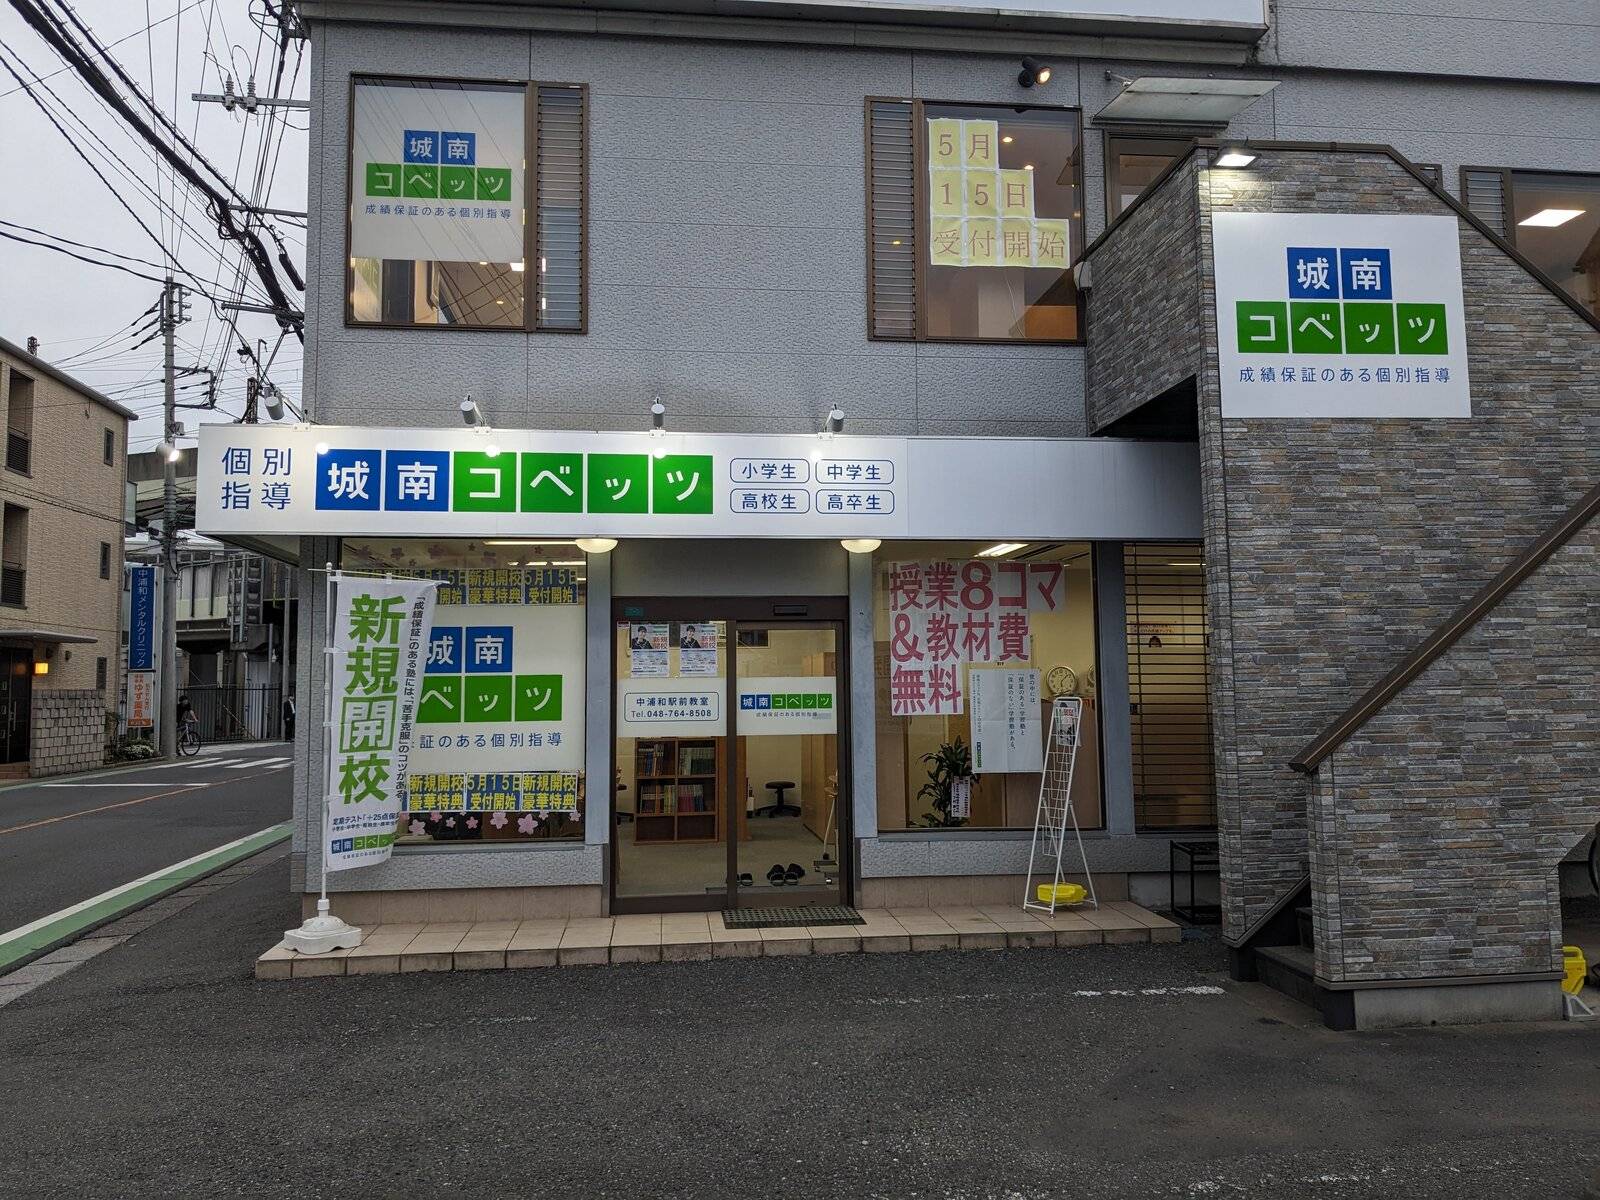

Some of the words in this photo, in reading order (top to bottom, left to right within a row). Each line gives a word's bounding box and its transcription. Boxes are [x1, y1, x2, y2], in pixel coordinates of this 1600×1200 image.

[410, 137, 468, 159] 城南
[938, 133, 990, 160] 5月
[374, 172, 503, 194] コベッツ
[941, 182, 1026, 208] 15日
[365, 204, 513, 219] 成績保証のある個別指導
[934, 229, 1065, 259] 受付開始
[1296, 258, 1381, 290] 城南
[1250, 313, 1435, 343] コベッツ
[1239, 366, 1450, 383] 成績保証のある個別指導
[221, 446, 292, 476] 個別
[742, 462, 797, 480] 小学生
[827, 464, 881, 480] 中学生
[327, 461, 699, 501] 城南コベッツ
[221, 481, 292, 510] 指導
[741, 493, 797, 510] 高校生
[827, 493, 881, 511] 高卒生
[469, 569, 522, 586] 新規開校
[525, 569, 576, 585] 5月15日
[890, 561, 1063, 611] 授業8コマ
[529, 587, 573, 604] 受付開始
[137, 569, 149, 667] 中浦和メンタルクリニック
[891, 612, 1029, 662] &教材費
[892, 664, 962, 714] 無料
[338, 593, 406, 805] 新規開校
[636, 697, 709, 707] 中浦和駅前教室
[742, 696, 830, 708] 城南コベッツ
[410, 774, 465, 791] 新規開校
[467, 774, 521, 790] 5月15日
[523, 774, 576, 791] 新規開校
[410, 794, 464, 811] 豪華特典
[471, 793, 516, 810] 受付開始
[523, 793, 576, 811] 豪華特典
